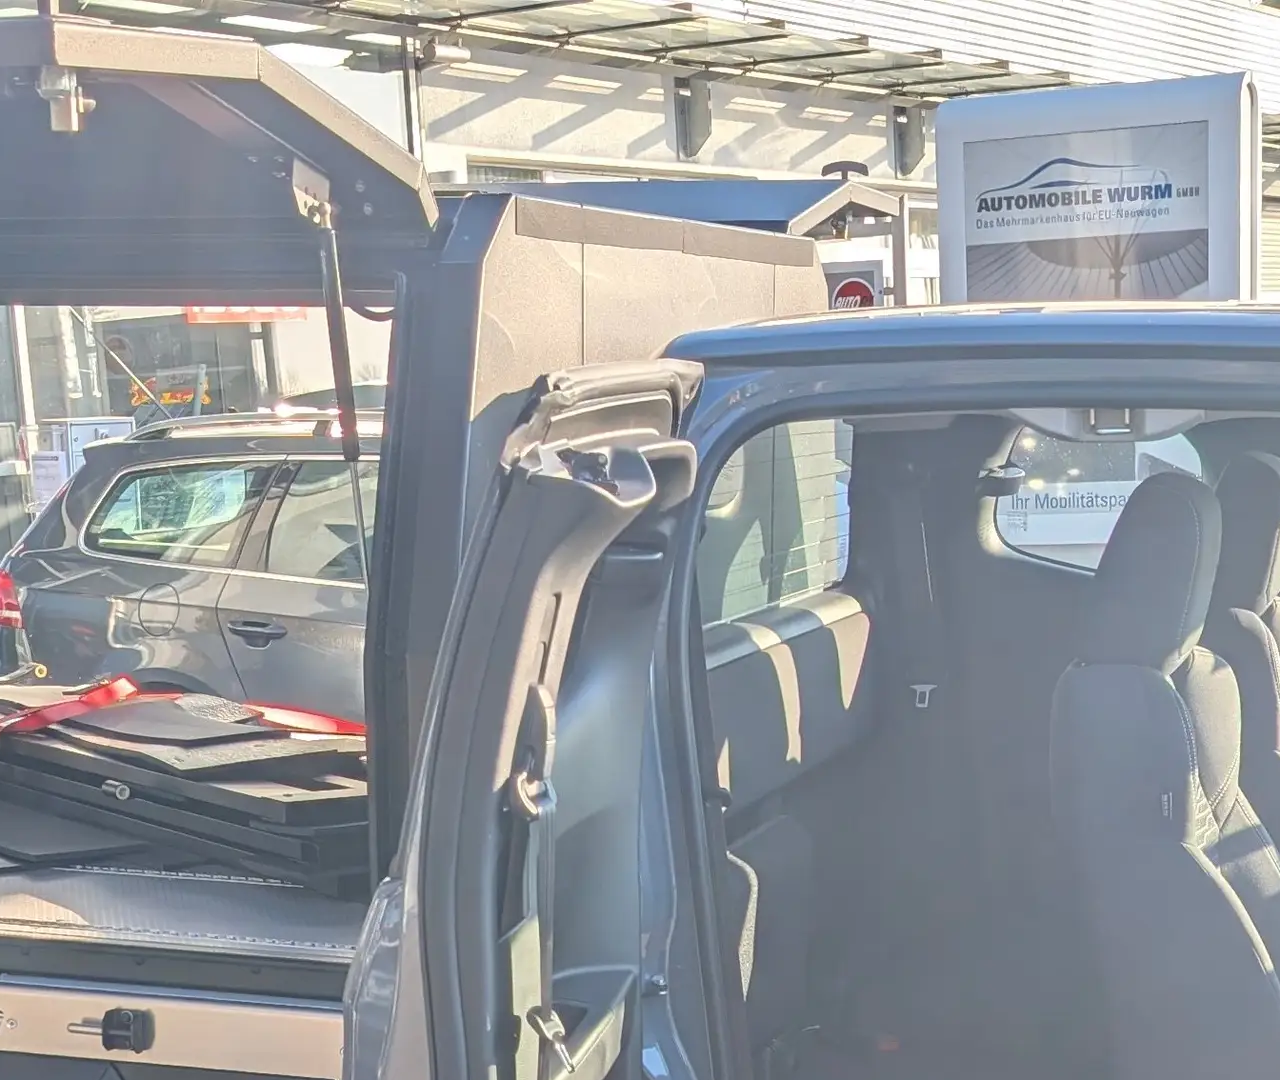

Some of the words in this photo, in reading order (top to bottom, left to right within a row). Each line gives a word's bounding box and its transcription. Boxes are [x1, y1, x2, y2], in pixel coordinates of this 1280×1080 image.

[976, 190, 1103, 212] AUTOMOBILE
[1107, 183, 1173, 203] WURM
[1176, 186, 1200, 198] GMBH
[976, 218, 995, 229] Das
[996, 213, 1081, 228] Mehrmarkenhaus
[1098, 206, 1170, 221] EU-Neuwagen
[1011, 494, 1030, 510] Ihr
[1035, 490, 1129, 512] Mobilitätspa
